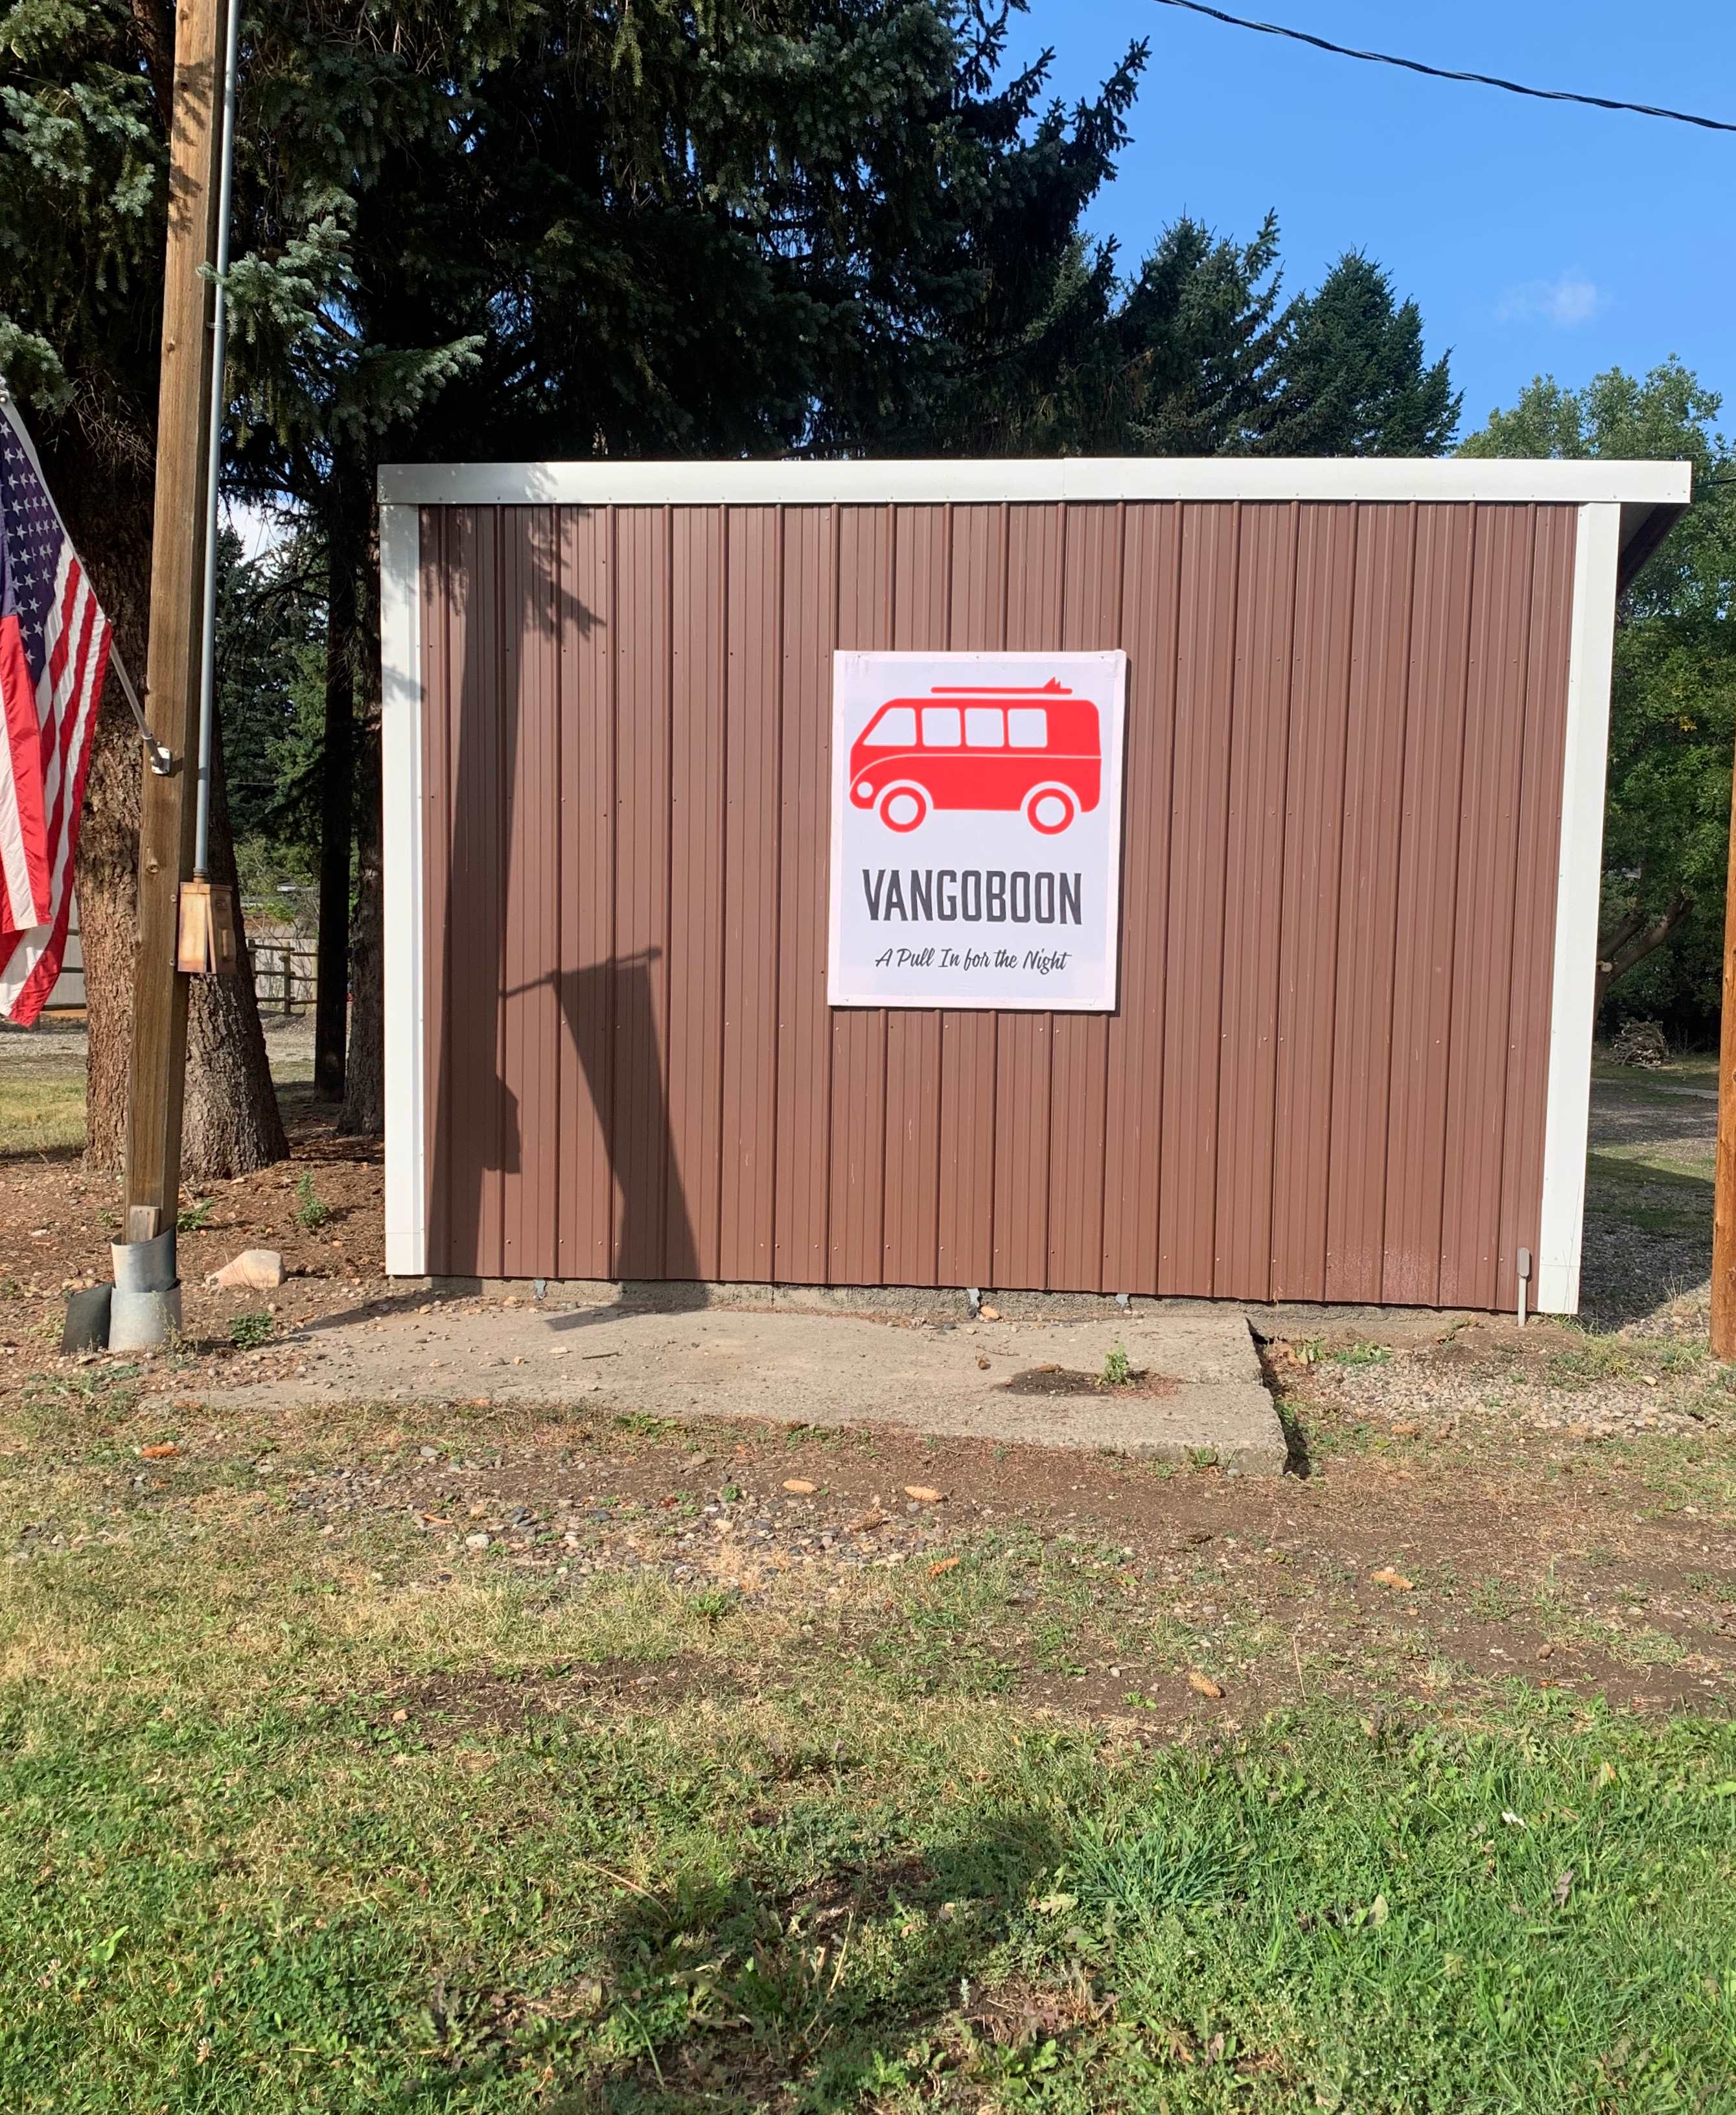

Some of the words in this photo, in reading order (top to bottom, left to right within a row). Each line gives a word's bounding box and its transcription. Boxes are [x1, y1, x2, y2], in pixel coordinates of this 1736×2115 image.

[862, 869, 1083, 926] VANGOBOON
[875, 948, 894, 967] A
[896, 947, 935, 967] Pull
[938, 948, 960, 968] In
[963, 948, 991, 971] for
[993, 949, 1017, 969] the
[1023, 948, 1072, 976] Night
